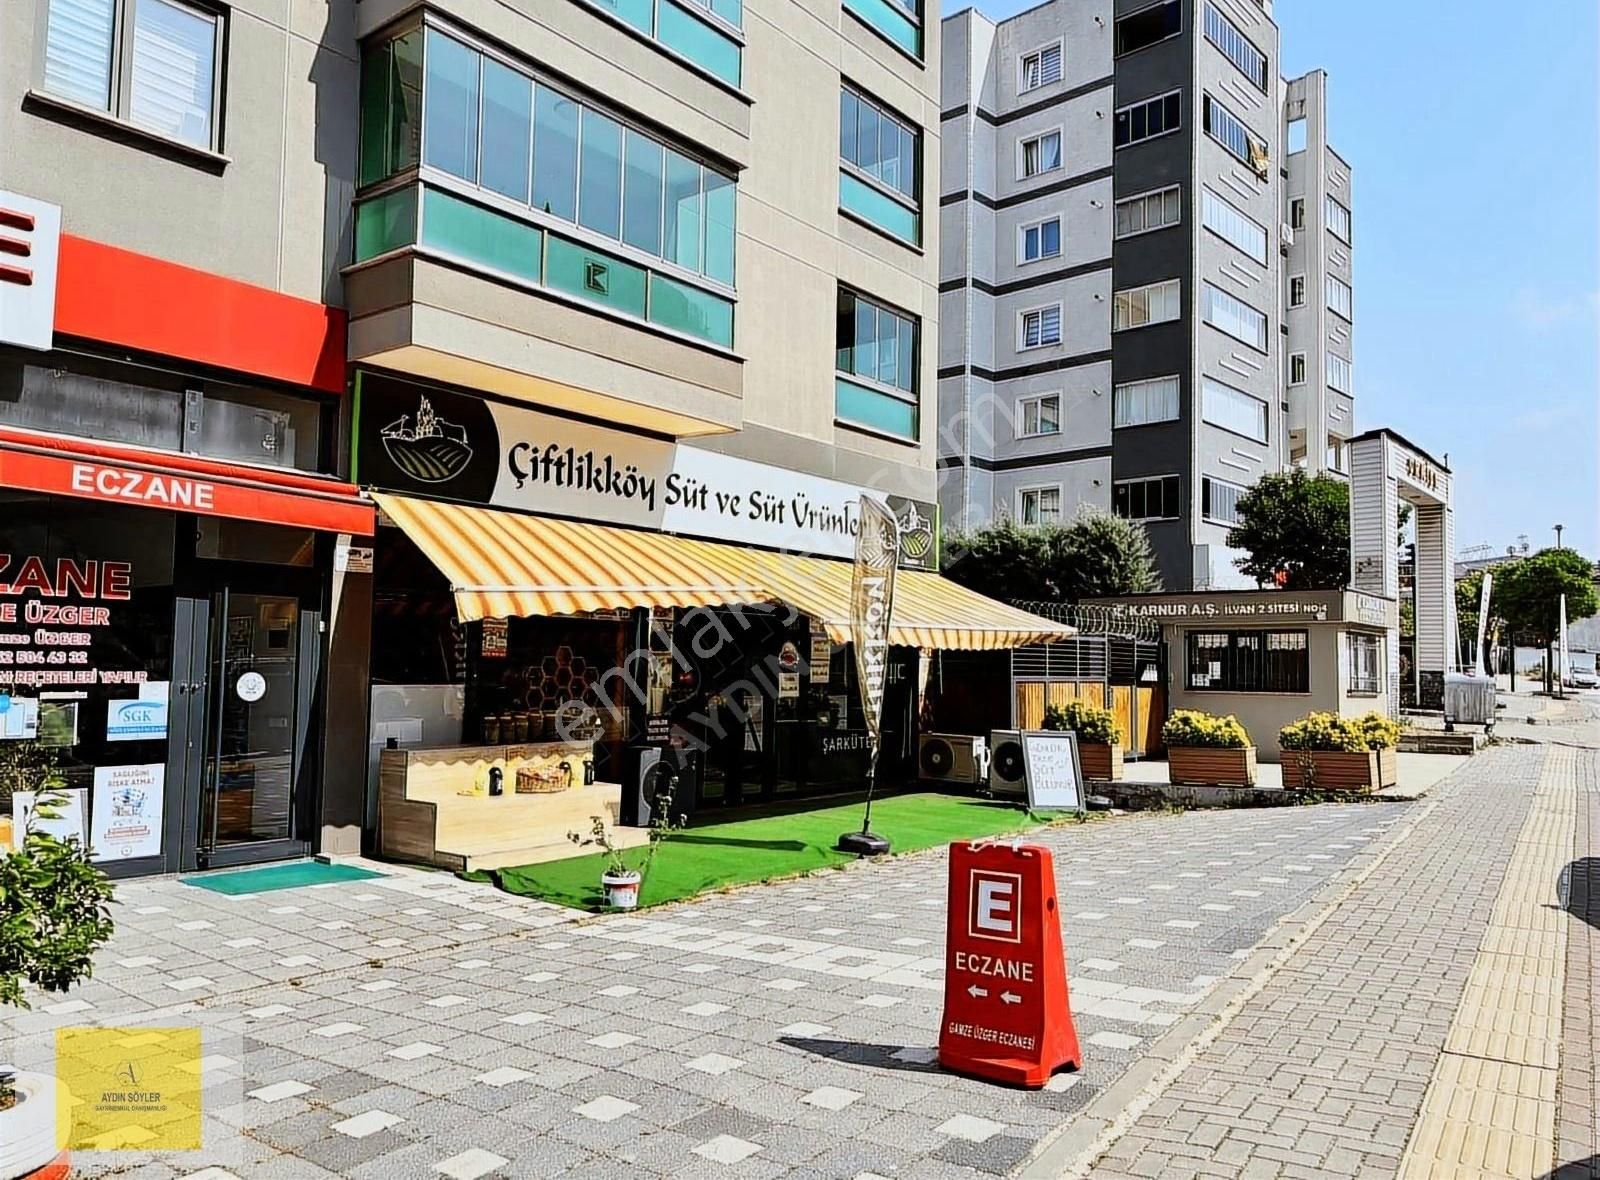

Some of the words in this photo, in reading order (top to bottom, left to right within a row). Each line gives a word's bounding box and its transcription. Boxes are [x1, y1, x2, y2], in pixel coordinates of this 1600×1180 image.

[71, 463, 214, 509] ECZANE
[508, 442, 655, 512] Çiftlikköy
[665, 474, 708, 511] Süt
[716, 492, 741, 517] ve
[749, 491, 786, 524] Süt
[792, 492, 862, 537] Ürünle
[0, 553, 132, 600] ANE
[25, 599, 110, 626] ÜZGER
[1129, 604, 1188, 617] KARNUR
[123, 710, 152, 722] SGK
[823, 733, 880, 755] ŞARKÜTE
[977, 880, 1012, 932] E
[956, 951, 1034, 983] ECZANE
